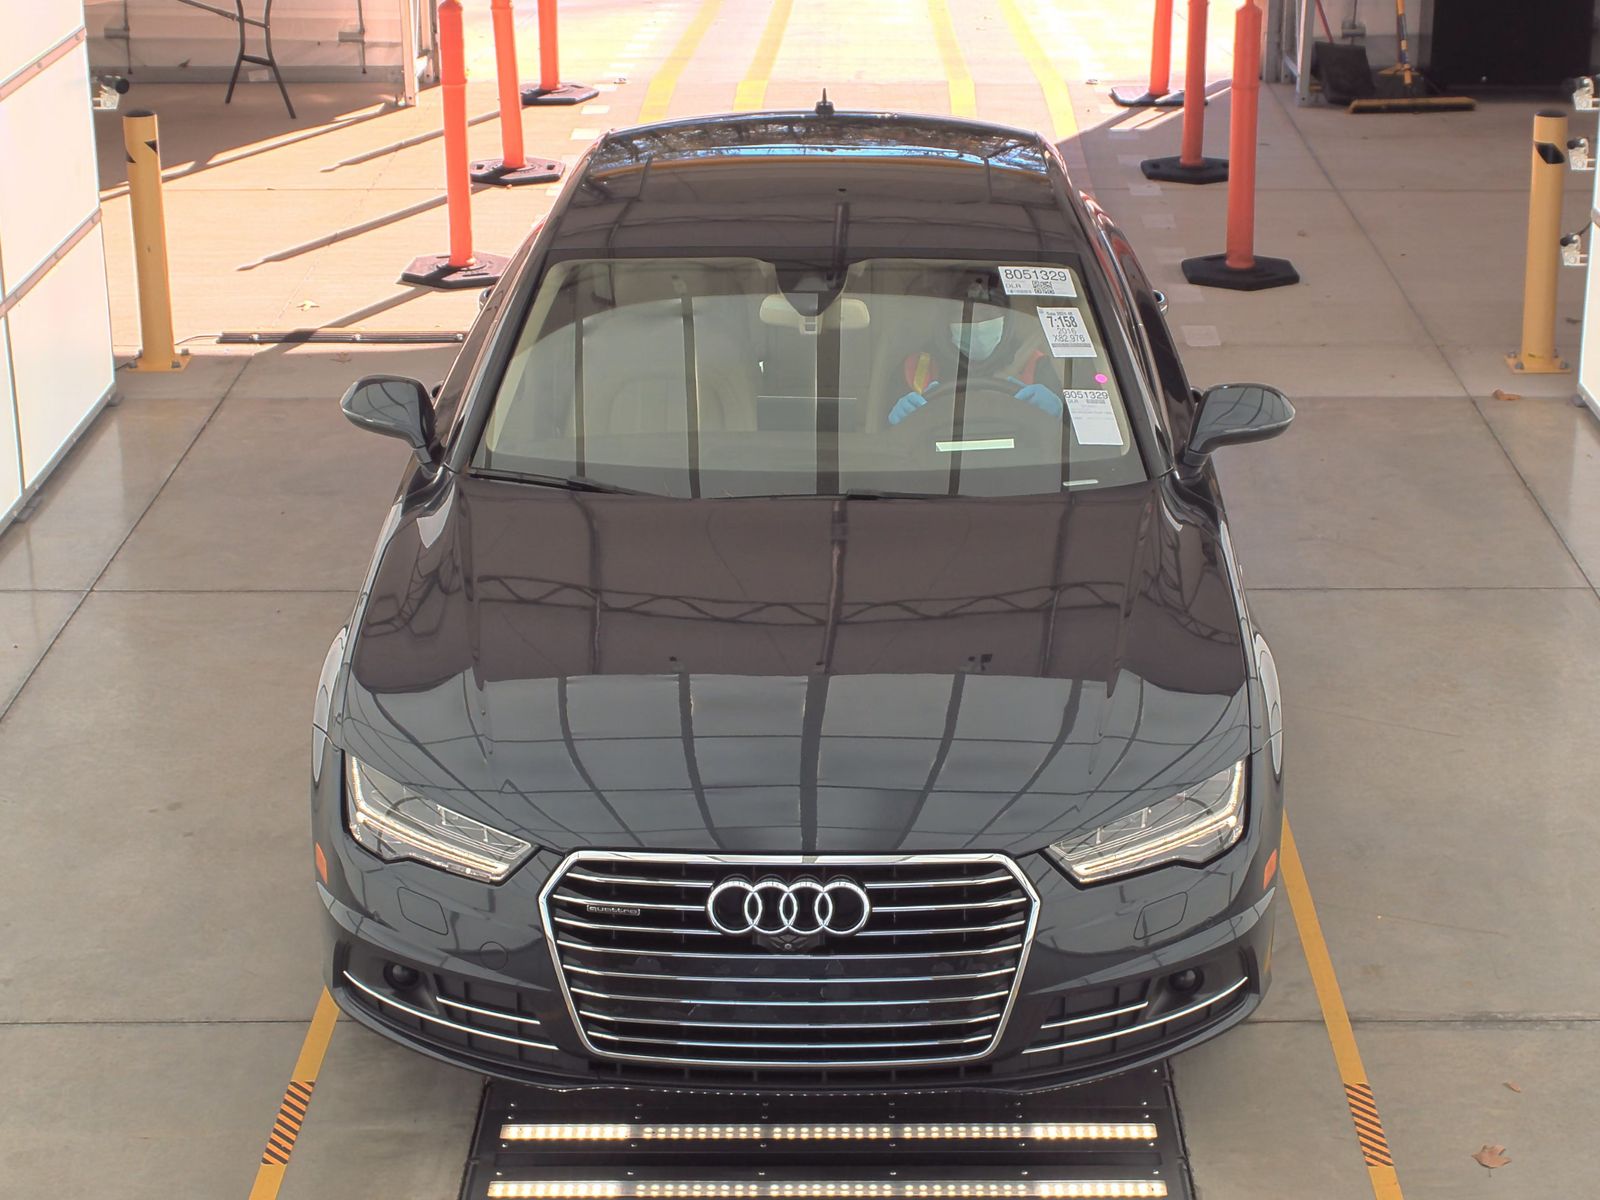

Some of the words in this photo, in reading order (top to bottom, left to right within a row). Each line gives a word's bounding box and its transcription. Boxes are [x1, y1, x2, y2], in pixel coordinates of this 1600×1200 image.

[1004, 269, 1067, 281] 8051329
[1046, 316, 1078, 328] 7:158
[1063, 391, 1109, 400] 8051329
